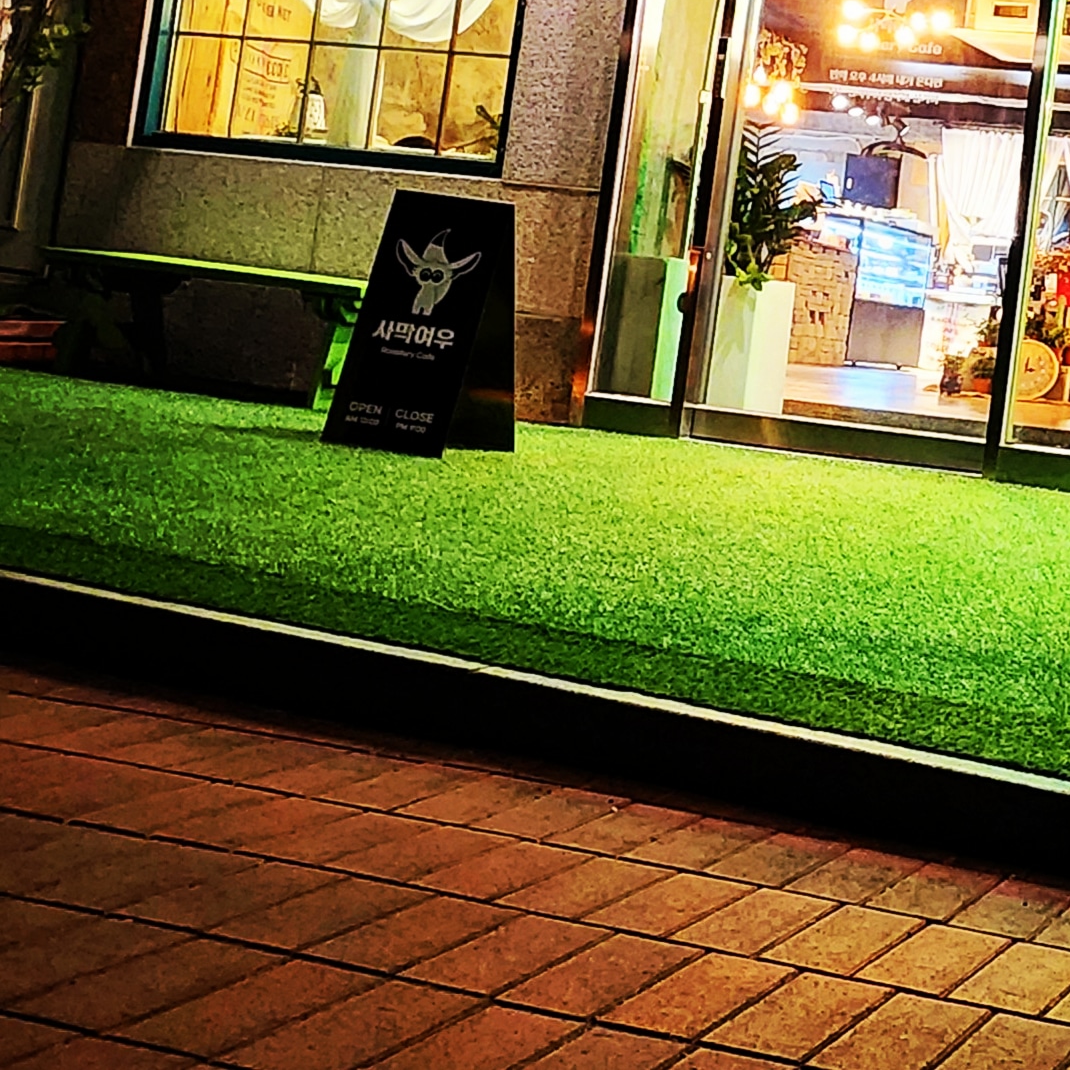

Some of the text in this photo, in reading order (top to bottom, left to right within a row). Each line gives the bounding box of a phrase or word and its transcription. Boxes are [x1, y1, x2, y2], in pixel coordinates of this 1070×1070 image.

[371, 319, 455, 350] 사막여우
[349, 401, 383, 416] OPEN
[394, 408, 434, 424] CLOSE
